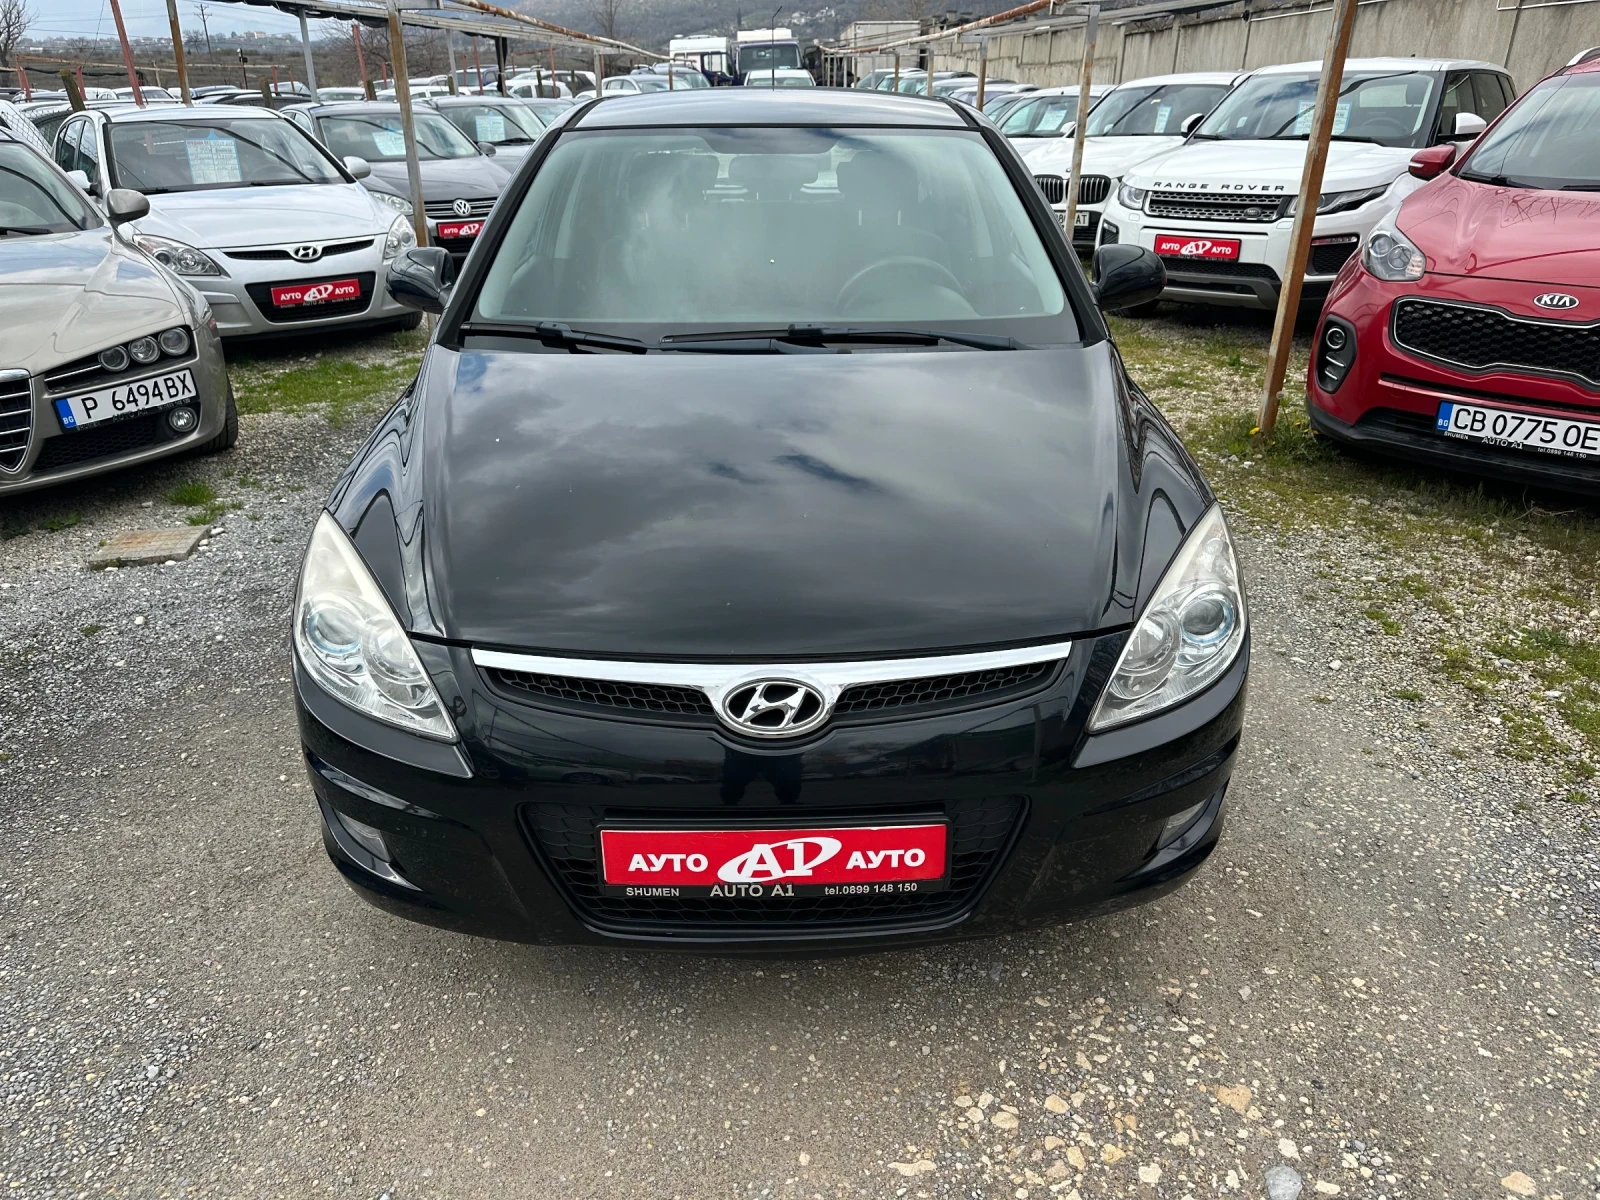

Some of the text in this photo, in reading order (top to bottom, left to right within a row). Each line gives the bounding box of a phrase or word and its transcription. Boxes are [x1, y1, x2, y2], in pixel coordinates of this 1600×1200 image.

[1153, 181, 1209, 190] RANGE
[1076, 214, 1087, 224] AT
[1160, 242, 1180, 250] АУТО
[280, 292, 302, 300] АУТО
[335, 286, 354, 295] АУТО
[1540, 294, 1570, 306] KIA
[62, 416, 74, 424] BG
[81, 396, 98, 419] P
[1438, 418, 1449, 427] BG
[1454, 408, 1487, 432] CB
[1492, 414, 1558, 443] 0775
[1482, 436, 1508, 447] AUTO
[1511, 441, 1523, 449] A1
[628, 838, 926, 881] АУТО A1 АУТО
[626, 883, 918, 897] SHUMEN AUTO A1 tel.0899 148 150
